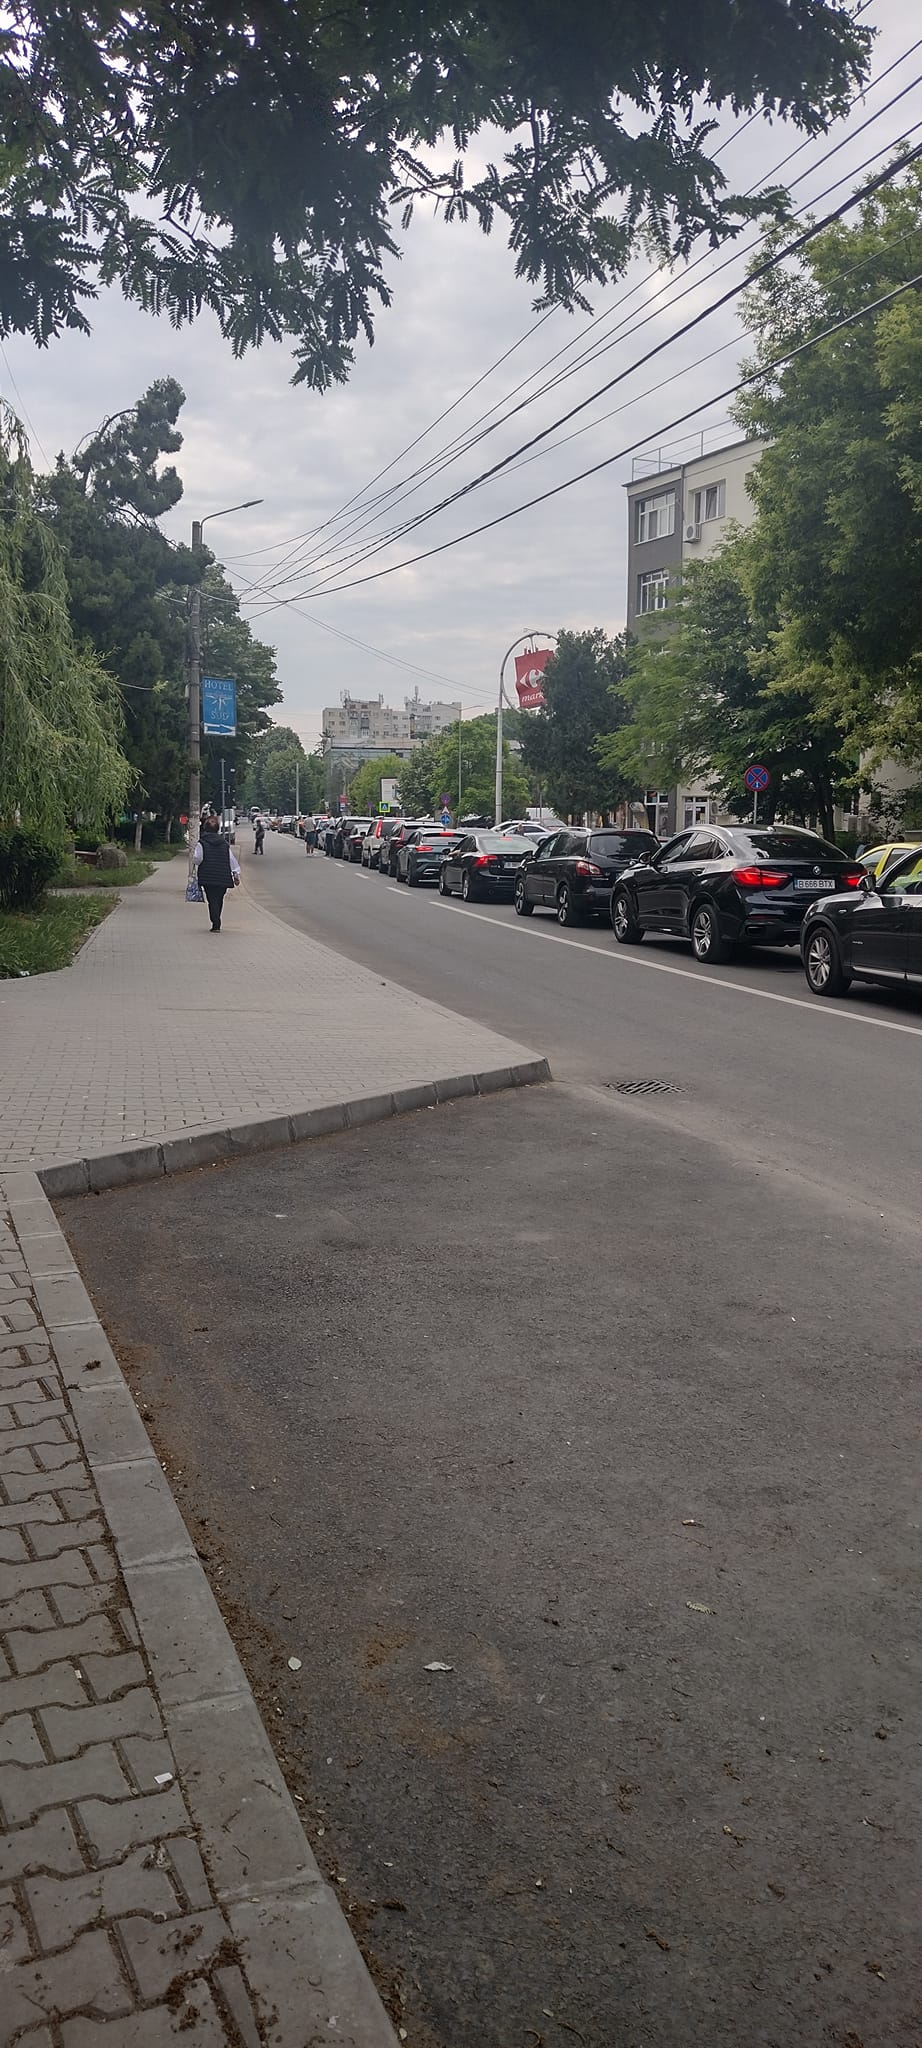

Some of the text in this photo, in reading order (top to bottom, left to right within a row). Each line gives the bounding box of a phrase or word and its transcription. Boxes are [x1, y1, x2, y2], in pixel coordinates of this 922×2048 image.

[204, 680, 234, 691] HOTEL
[521, 691, 544, 702] mark
[798, 880, 804, 889] B
[818, 880, 833, 889] BTX
